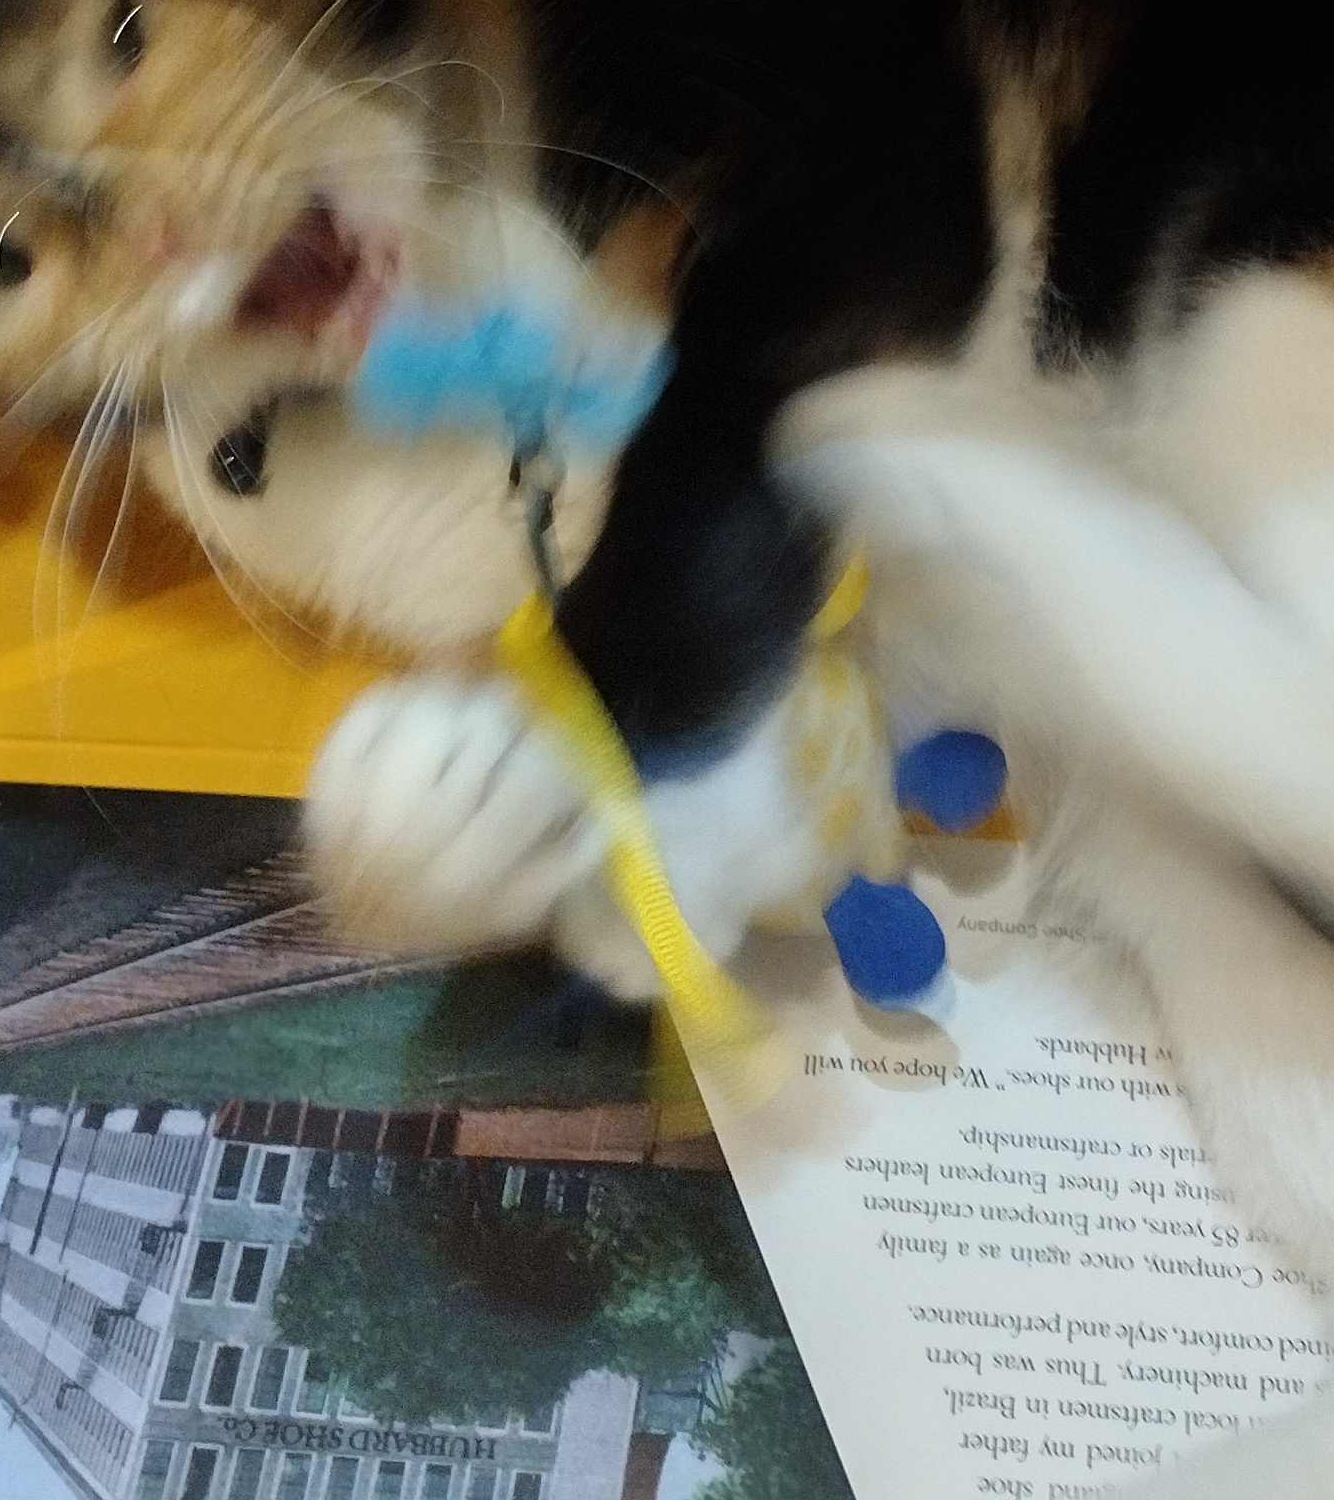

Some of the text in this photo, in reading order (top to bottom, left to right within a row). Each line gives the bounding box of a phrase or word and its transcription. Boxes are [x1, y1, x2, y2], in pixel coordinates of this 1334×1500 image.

[957, 915, 1038, 940] Company
[1035, 1036, 1146, 1066] Hubbards.
[804, 1053, 844, 1077] will
[851, 1055, 887, 1075] you
[893, 1058, 948, 1086] hope
[953, 1065, 990, 1090] We
[1076, 1074, 1115, 1091] our
[1121, 1077, 1171, 1101] with
[958, 1125, 1213, 1169] rials or craftsmanship.
[845, 1155, 929, 1185] leathers
[940, 1162, 1047, 1194] European
[1058, 1174, 1118, 1201] finest
[1130, 1179, 1165, 1204] the
[863, 1193, 974, 1223] craftsmen
[980, 1203, 1089, 1236] European
[1097, 1215, 1136, 1230] our
[1143, 1215, 1206, 1238] years,
[878, 1230, 947, 1263] family
[958, 1240, 970, 1256] a
[979, 1242, 1001, 1257] as
[1212, 1225, 1239, 1248] 85
[1011, 1244, 1071, 1267] again
[1080, 1251, 1135, 1271] once
[1144, 1253, 1263, 1288] Company,
[907, 1304, 1061, 1339] performance.
[1067, 1317, 1111, 1343] and
[1116, 1319, 1167, 1349] style
[1173, 1323, 1273, 1356] comfort,
[925, 1347, 982, 1376] born
[993, 1351, 1036, 1372] was
[1045, 1357, 1107, 1386] Thus
[1118, 1360, 1247, 1395] machinery.
[1259, 1375, 1305, 1401] and
[942, 1386, 1017, 1419] Brazil,
[1025, 1396, 1049, 1420] in
[1058, 1399, 1177, 1431] craftsmen
[267, 1421, 344, 1449] SHOE
[1184, 1409, 1240, 1436] local
[349, 1426, 497, 1460] HUBBARD
[959, 1432, 1029, 1463] father
[1039, 1434, 1075, 1459] my
[1086, 1443, 1163, 1470] joined
